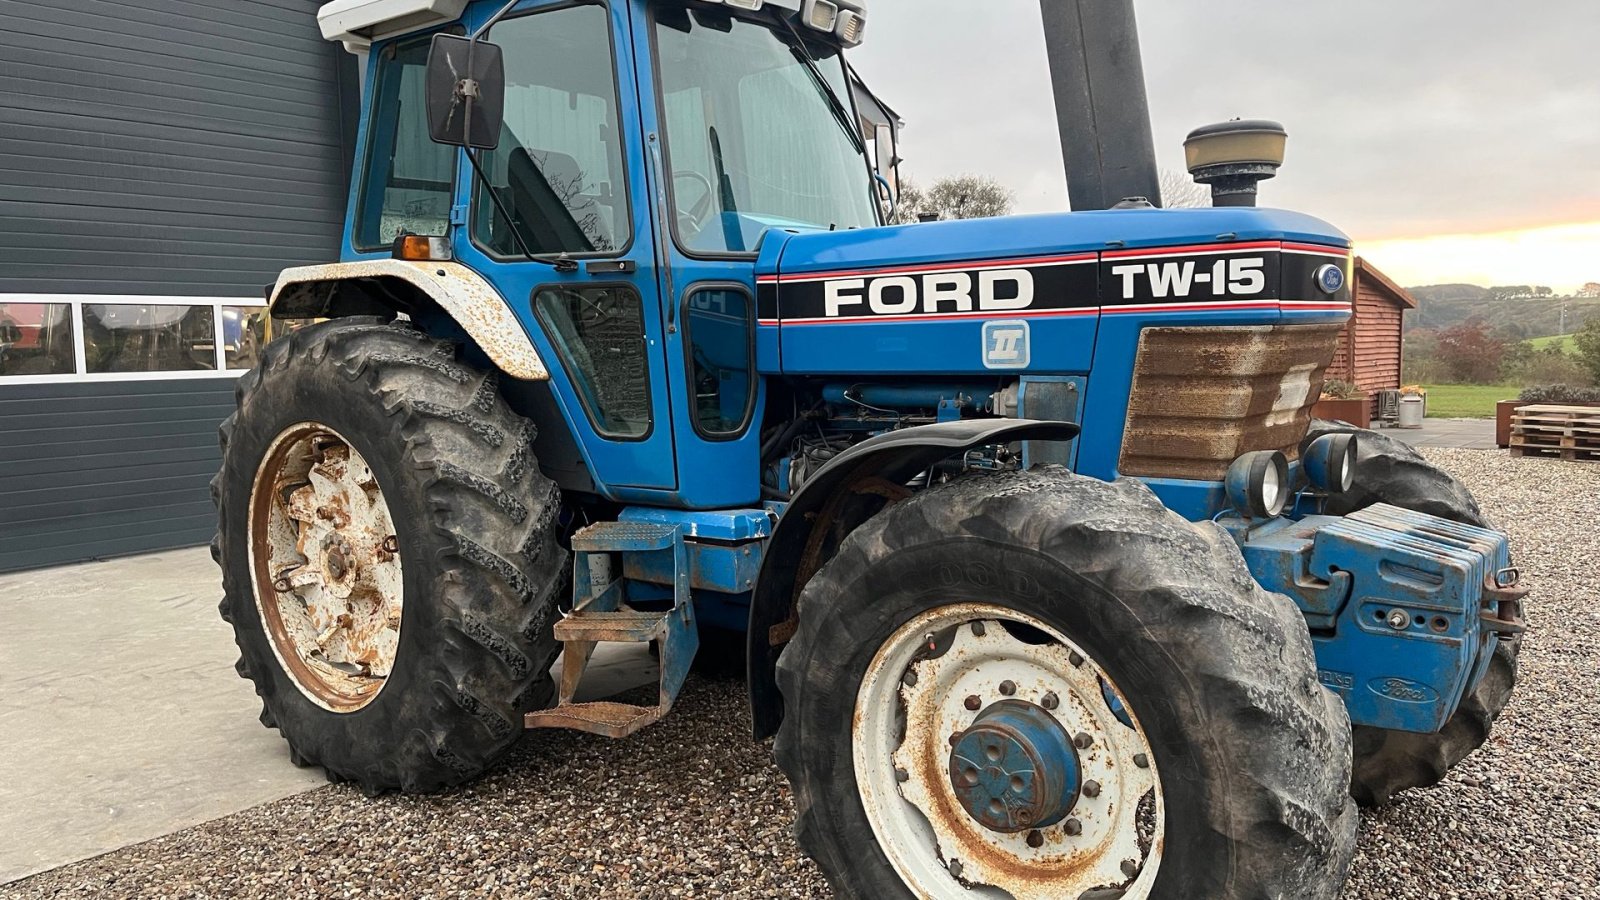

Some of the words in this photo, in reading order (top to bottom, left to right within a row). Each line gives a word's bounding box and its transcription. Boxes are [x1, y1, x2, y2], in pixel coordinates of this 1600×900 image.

[824, 268, 1035, 317] FORD
[1112, 257, 1265, 299] TW-15
[1381, 678, 1428, 700] Ford
